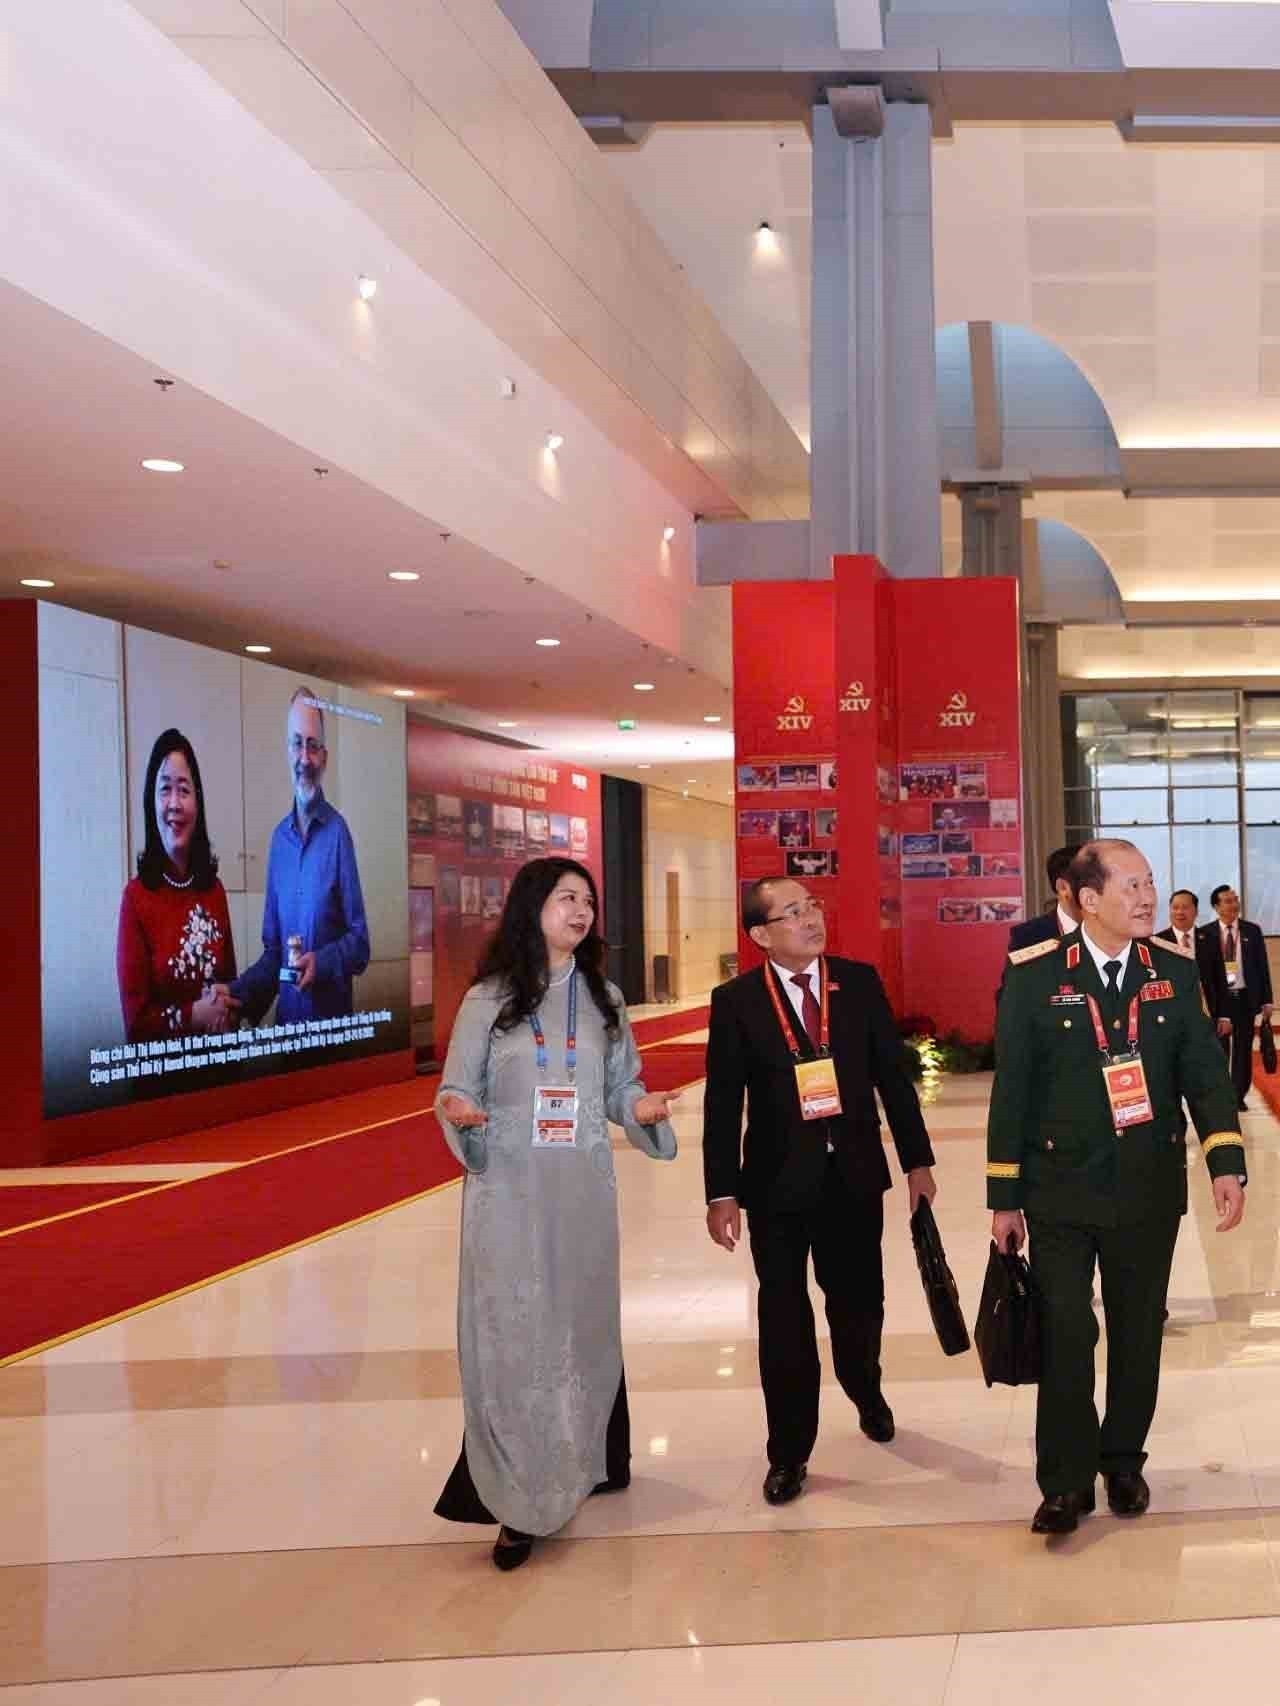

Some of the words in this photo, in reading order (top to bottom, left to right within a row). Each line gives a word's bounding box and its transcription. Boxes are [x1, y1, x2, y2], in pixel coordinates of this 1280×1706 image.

[839, 698, 872, 712] XIV
[776, 715, 814, 731] XIV
[938, 711, 976, 727] XIV
